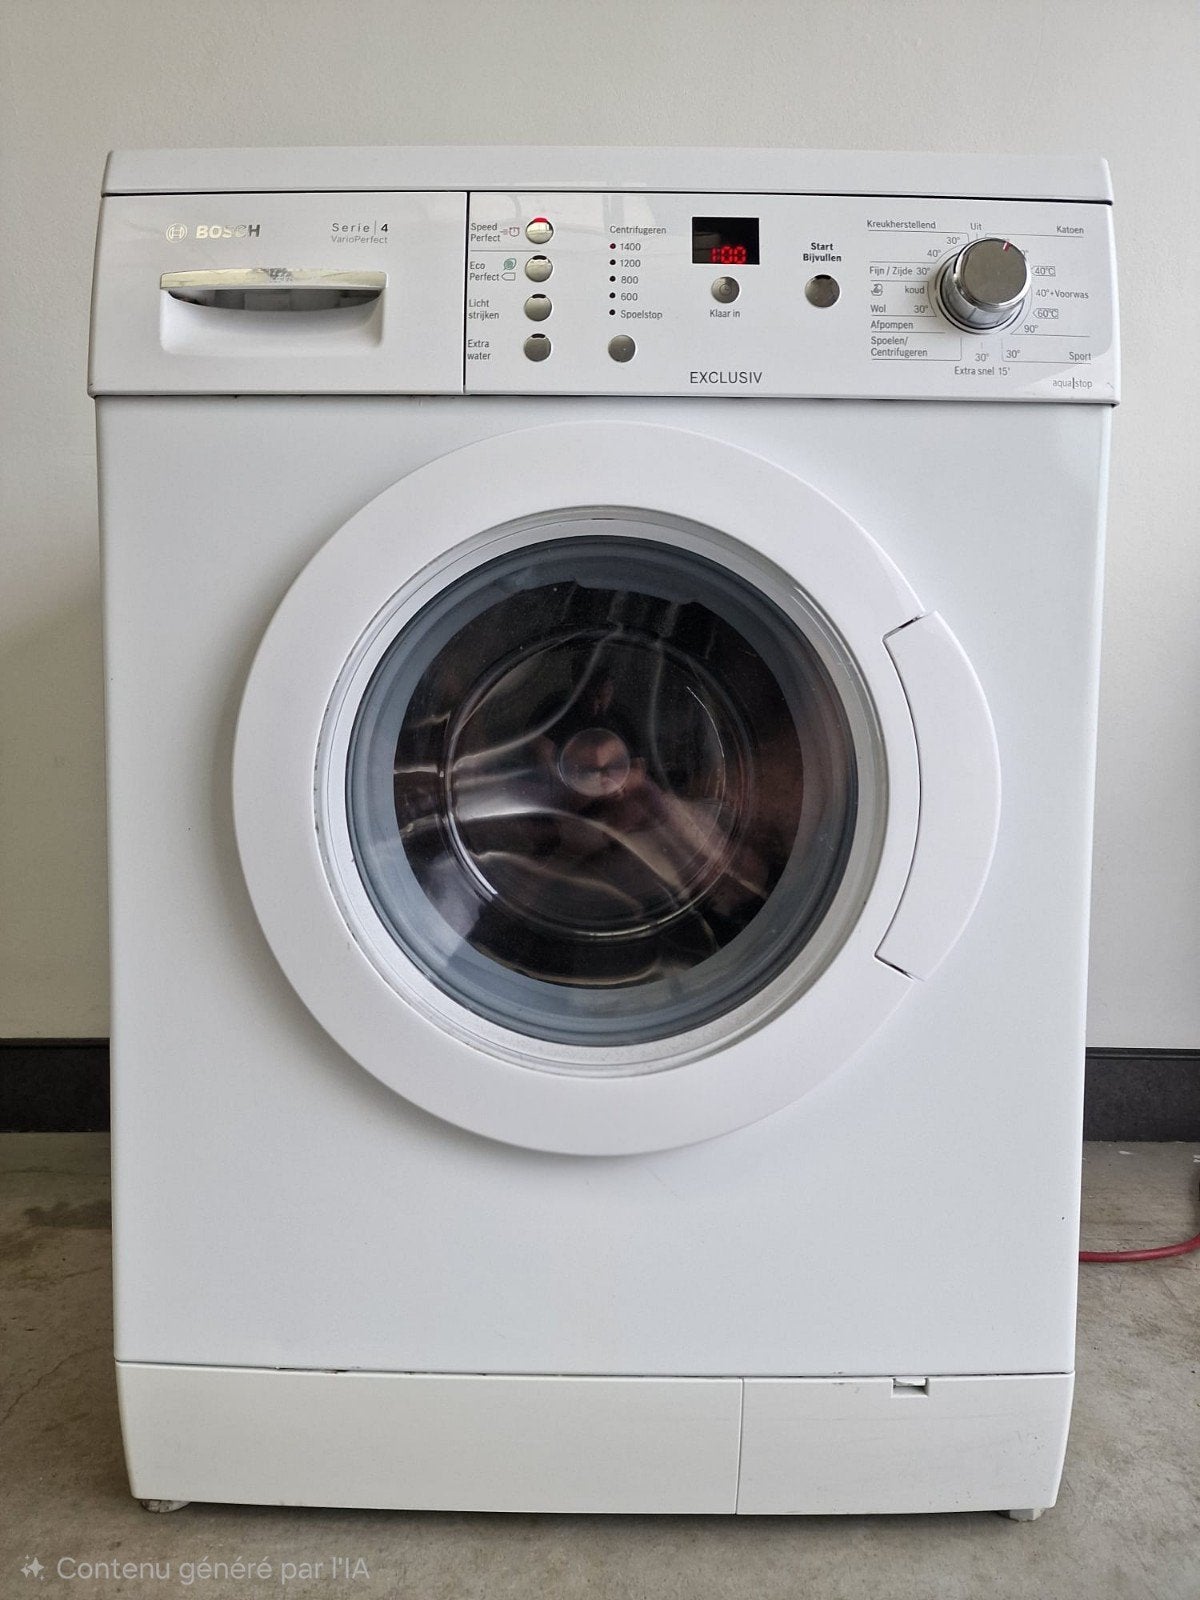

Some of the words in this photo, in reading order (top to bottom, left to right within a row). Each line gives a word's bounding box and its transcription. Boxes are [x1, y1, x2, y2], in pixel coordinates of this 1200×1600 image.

[332, 222, 370, 232] Serie
[380, 223, 389, 233] 4
[470, 222, 498, 232] Speed
[866, 219, 936, 229] Kreukherstellend
[970, 222, 982, 231] Uit
[195, 224, 261, 239] BOSCH
[609, 225, 667, 235] Centrifugeren
[1056, 225, 1084, 234] Katoen
[331, 235, 388, 243] VarioPerfect
[470, 233, 501, 242] Perfect
[946, 236, 960, 245] 30°
[620, 242, 642, 251] 1400
[810, 242, 834, 251] Start
[803, 253, 842, 263] Bijvullen
[927, 249, 941, 258] 40°
[469, 261, 485, 270] Eco
[620, 259, 641, 268] 1200
[869, 266, 885, 276] Fijn
[892, 266, 913, 277] Zijde
[916, 267, 930, 275] 30°
[469, 272, 500, 281] Perfect
[621, 276, 639, 284] 800
[904, 285, 925, 294] koud
[620, 292, 638, 301] 600
[468, 299, 490, 308] Licht
[709, 309, 731, 318] Klaar
[732, 309, 741, 318] in
[870, 304, 887, 313] Wol
[913, 305, 928, 314] 30°
[468, 310, 500, 321] strijken
[620, 309, 663, 320] Spoelstop
[870, 320, 914, 330] Afpompen
[1024, 325, 1038, 333] 90°
[467, 339, 490, 348] Extra
[870, 335, 908, 346] Spoelen/
[466, 352, 491, 360] water
[870, 347, 928, 358] Centrifugeren
[975, 353, 989, 361] 30°
[1006, 349, 1020, 358] 30°
[1068, 351, 1092, 362] Sport
[954, 366, 976, 375] Extra
[977, 366, 995, 375] snel
[690, 371, 763, 384] EXCLUSIV
